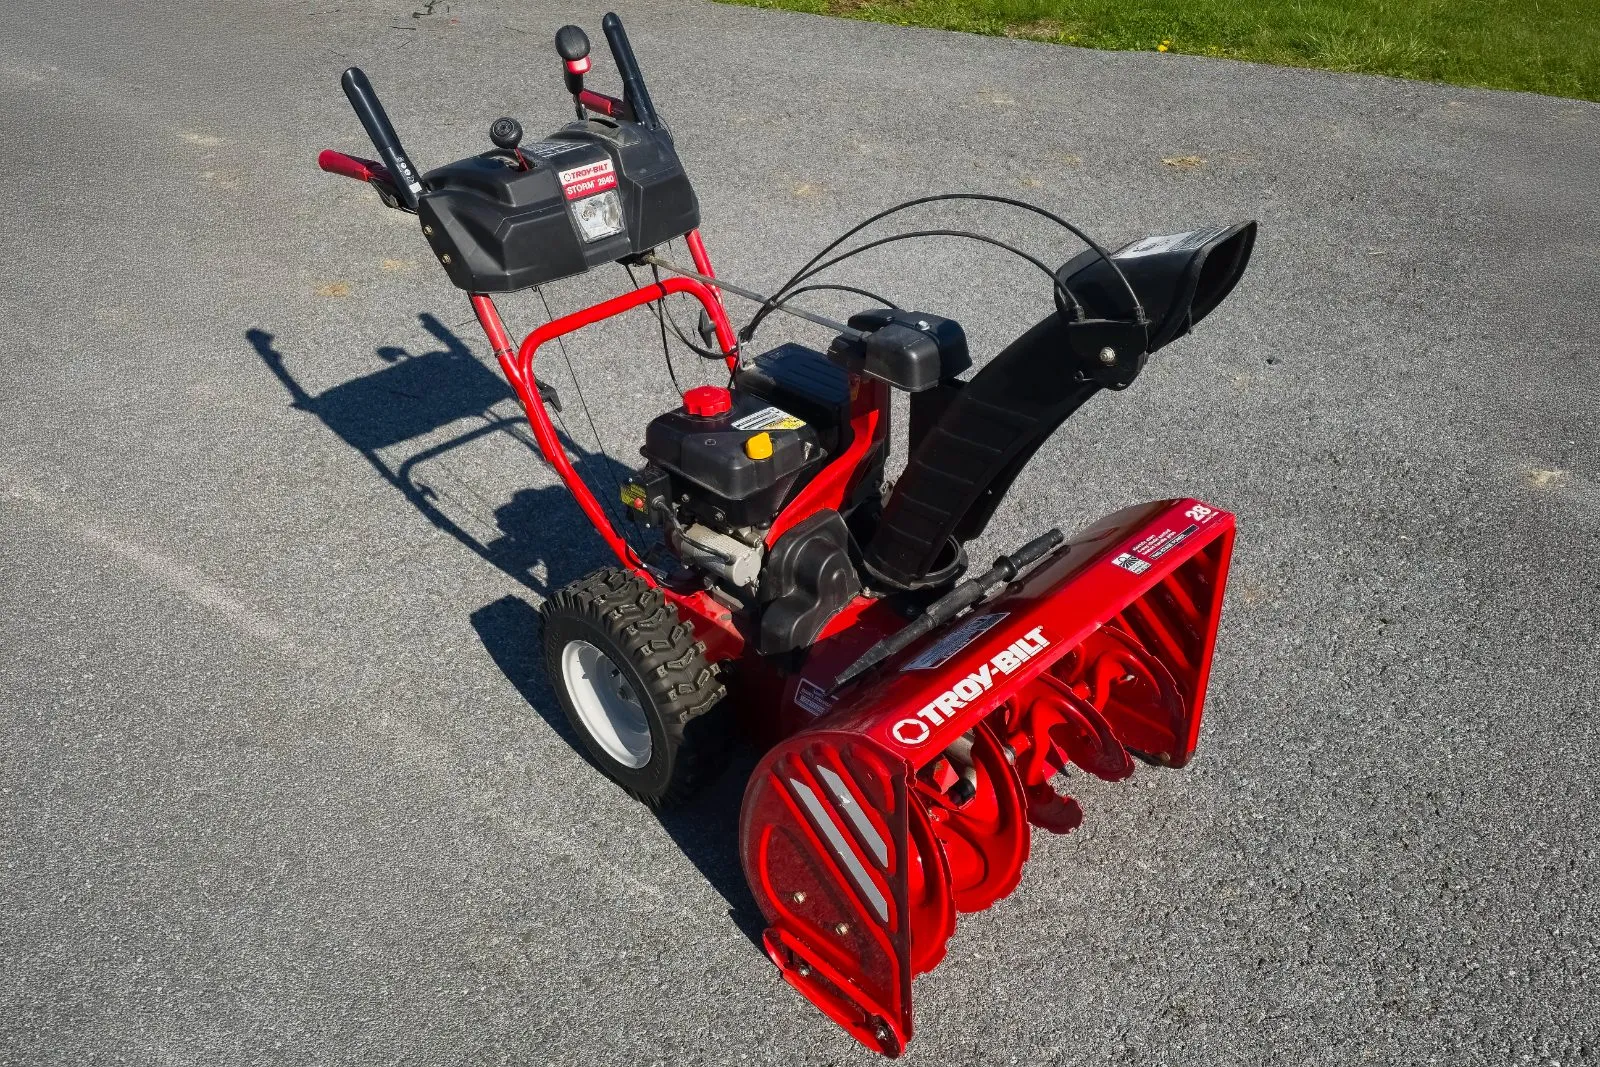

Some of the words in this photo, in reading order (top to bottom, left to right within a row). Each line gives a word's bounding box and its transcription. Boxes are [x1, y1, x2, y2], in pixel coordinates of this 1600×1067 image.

[571, 164, 608, 179] TROY-BILT
[597, 175, 615, 187] 2840
[917, 627, 1051, 727] TROY-BILT
